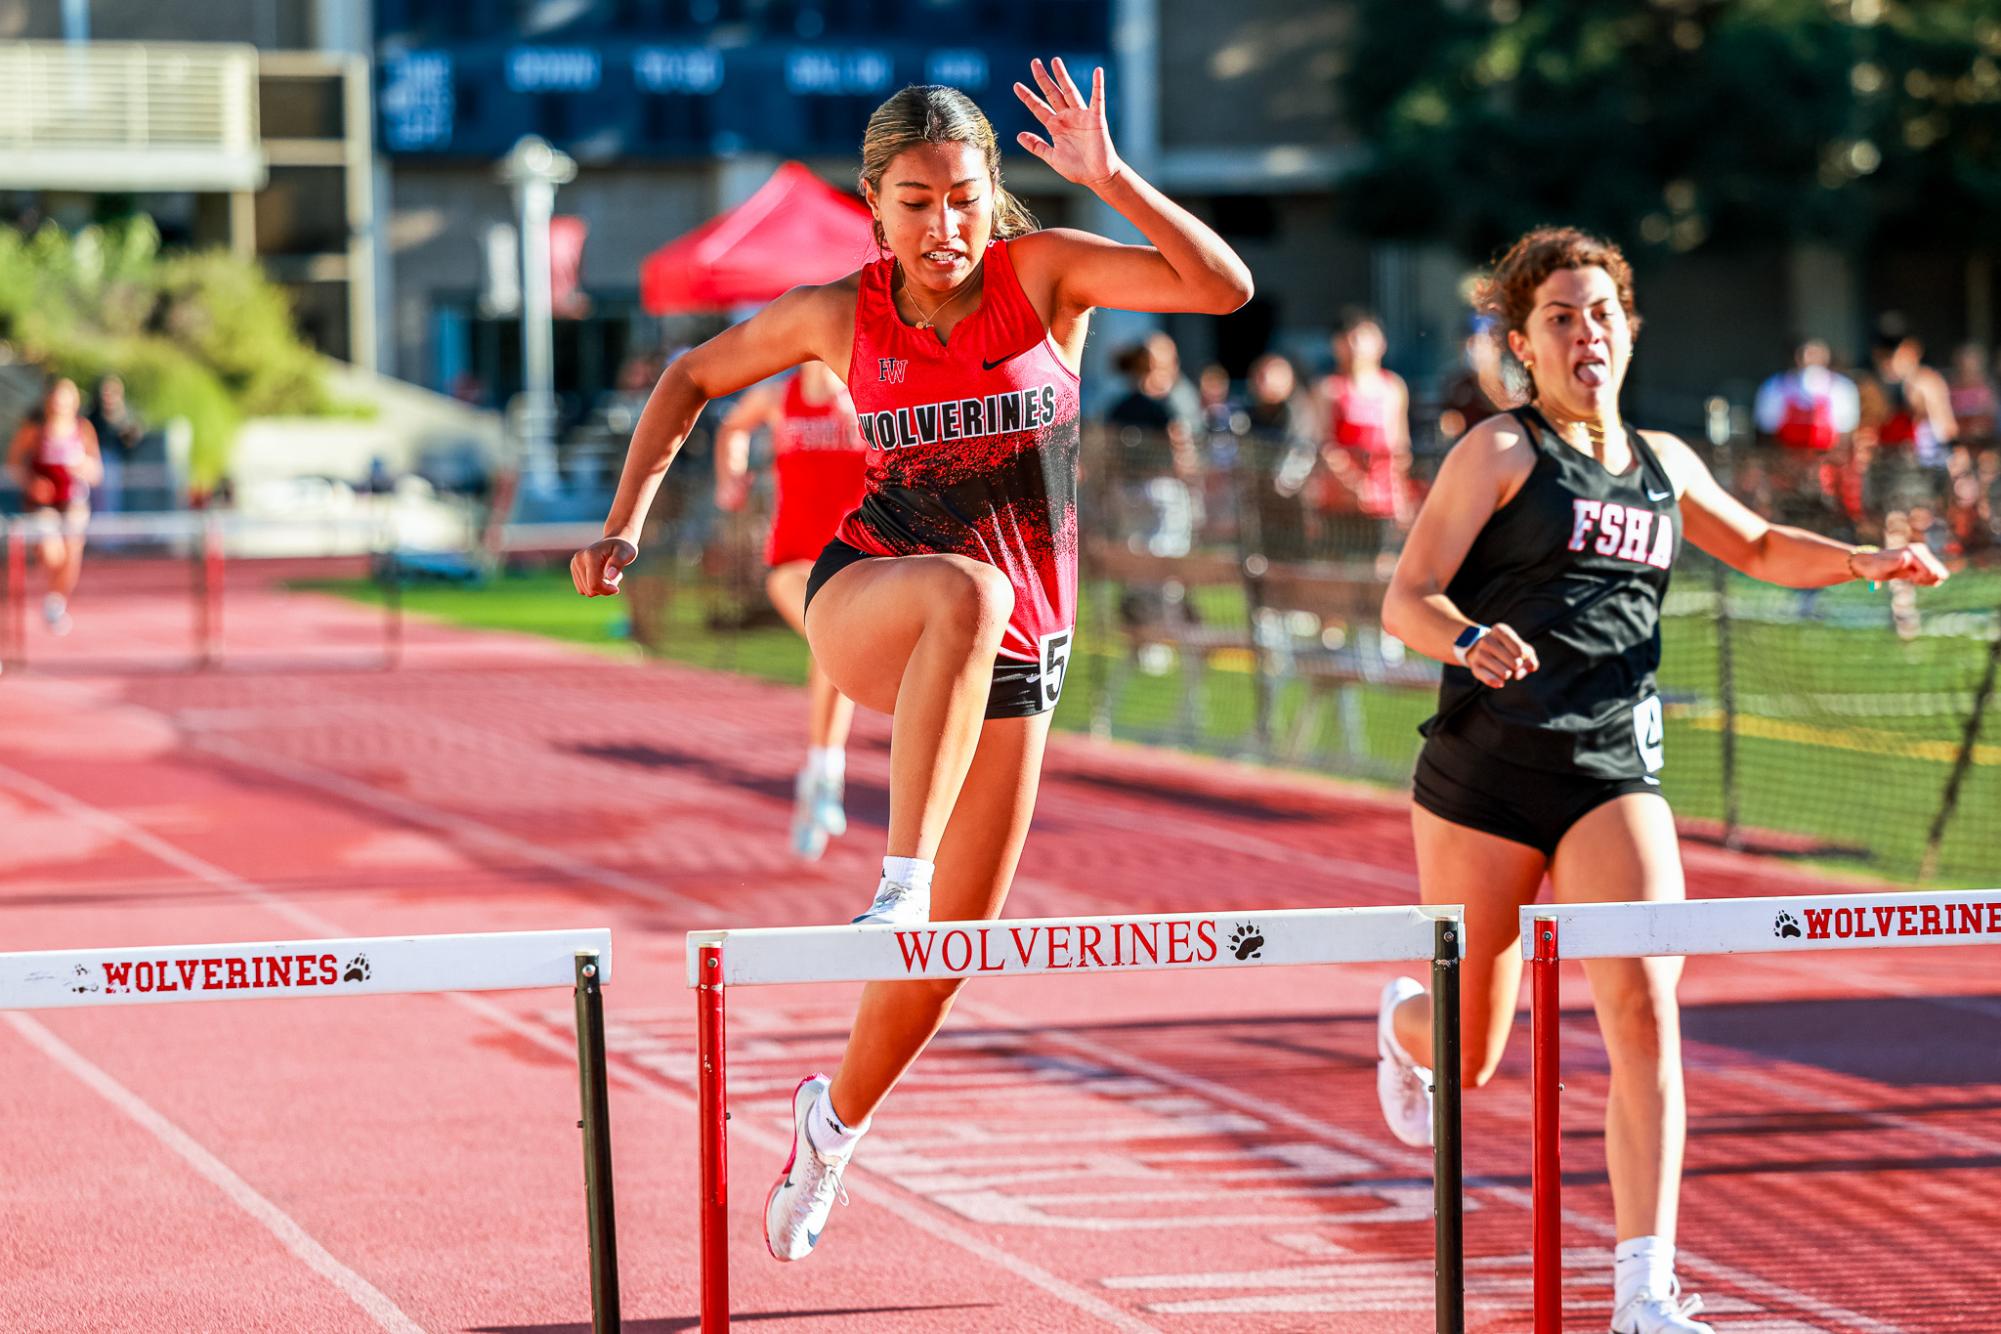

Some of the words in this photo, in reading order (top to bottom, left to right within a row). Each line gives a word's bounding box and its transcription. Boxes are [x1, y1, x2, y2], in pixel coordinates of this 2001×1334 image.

[857, 384, 1057, 451] WOLVERINES
[1567, 498, 1674, 570] FSHA
[1044, 633, 1069, 702] 5
[102, 953, 338, 995] WOLVERINES
[894, 919, 1219, 974] WOLVERINES
